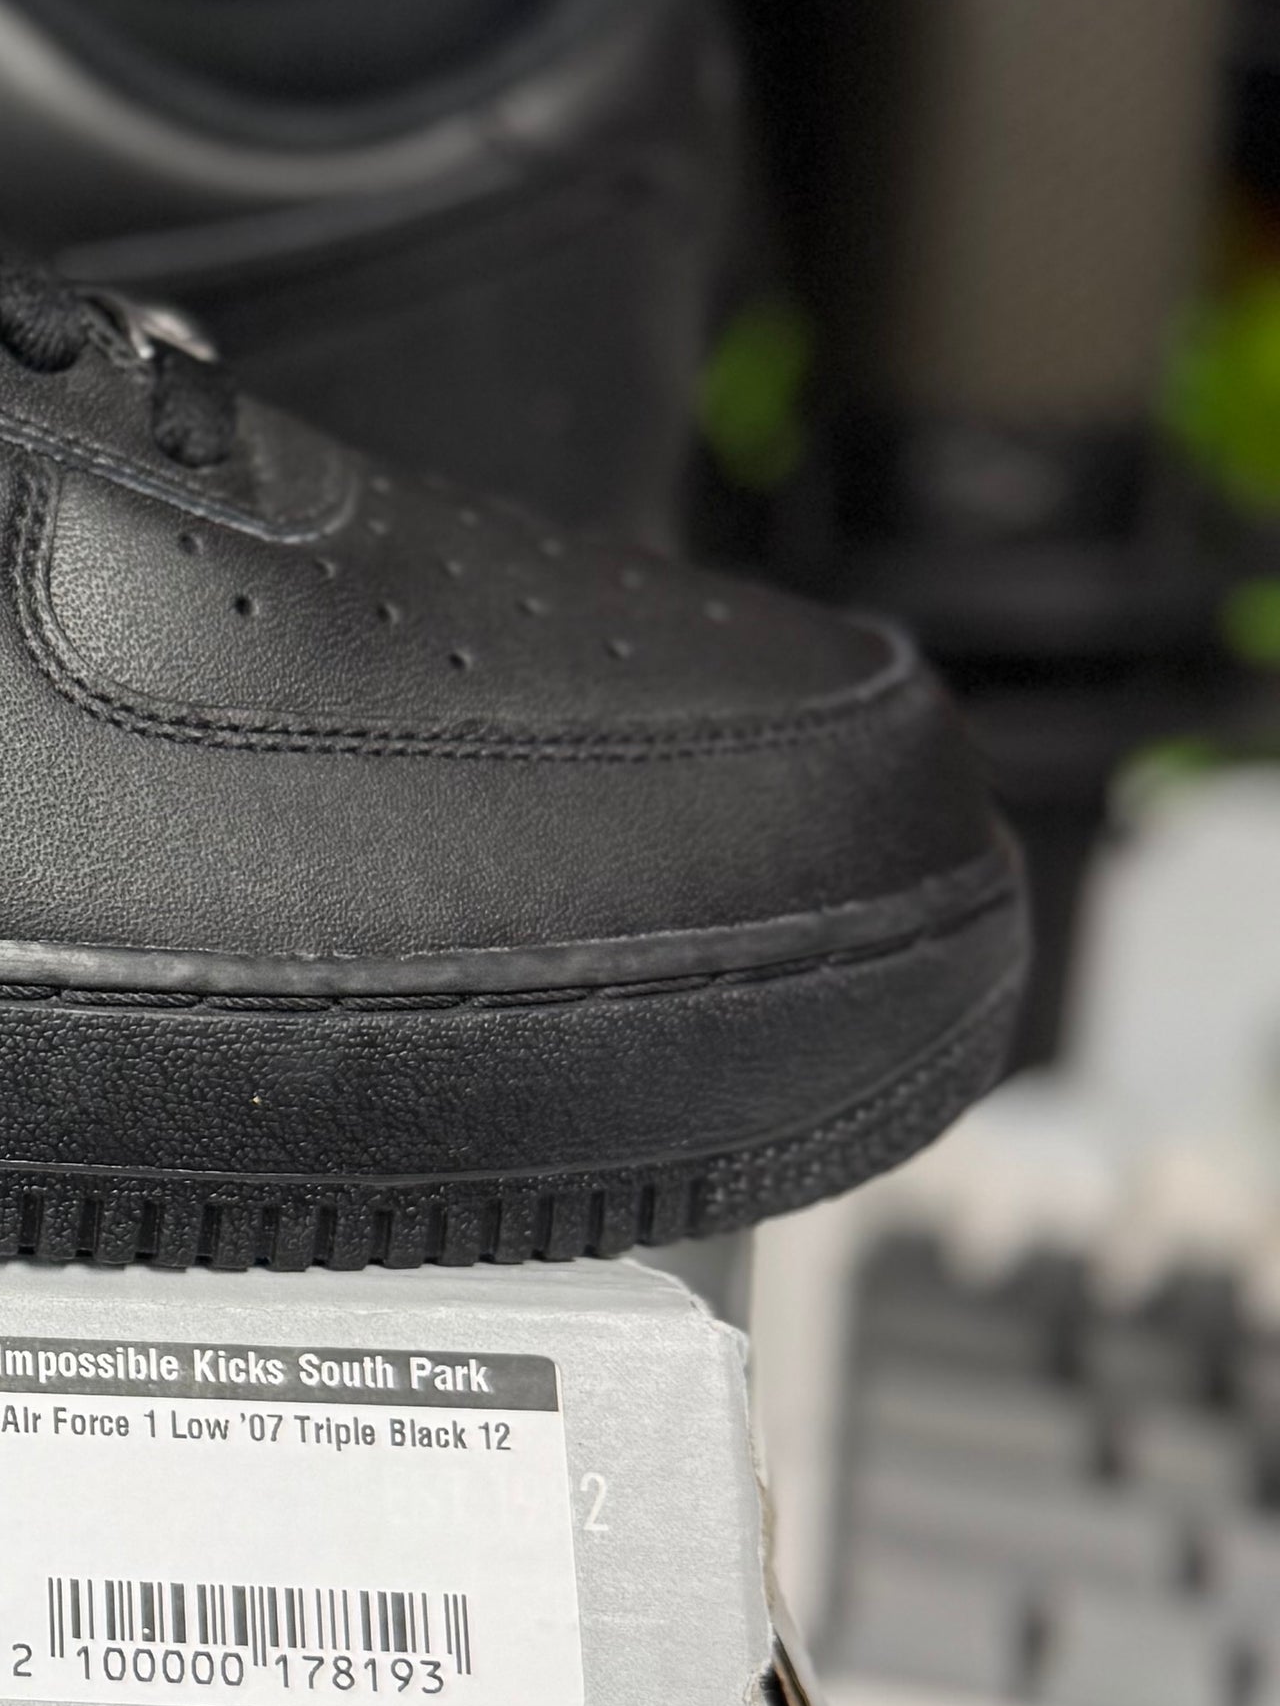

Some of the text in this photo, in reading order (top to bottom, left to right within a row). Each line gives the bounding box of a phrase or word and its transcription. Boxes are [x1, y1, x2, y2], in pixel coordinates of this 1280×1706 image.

[193, 1348, 285, 1385] Kicks
[297, 1352, 395, 1389] South
[409, 1356, 491, 1393] Park
[1, 1404, 41, 1434] Air
[52, 1406, 130, 1437] Force
[143, 1409, 156, 1439] 1
[171, 1410, 230, 1440] Low
[294, 1415, 376, 1452] Triple
[390, 1417, 468, 1450] Black
[478, 1421, 512, 1451] 12
[12, 1643, 445, 1695] 2 100000 178193
